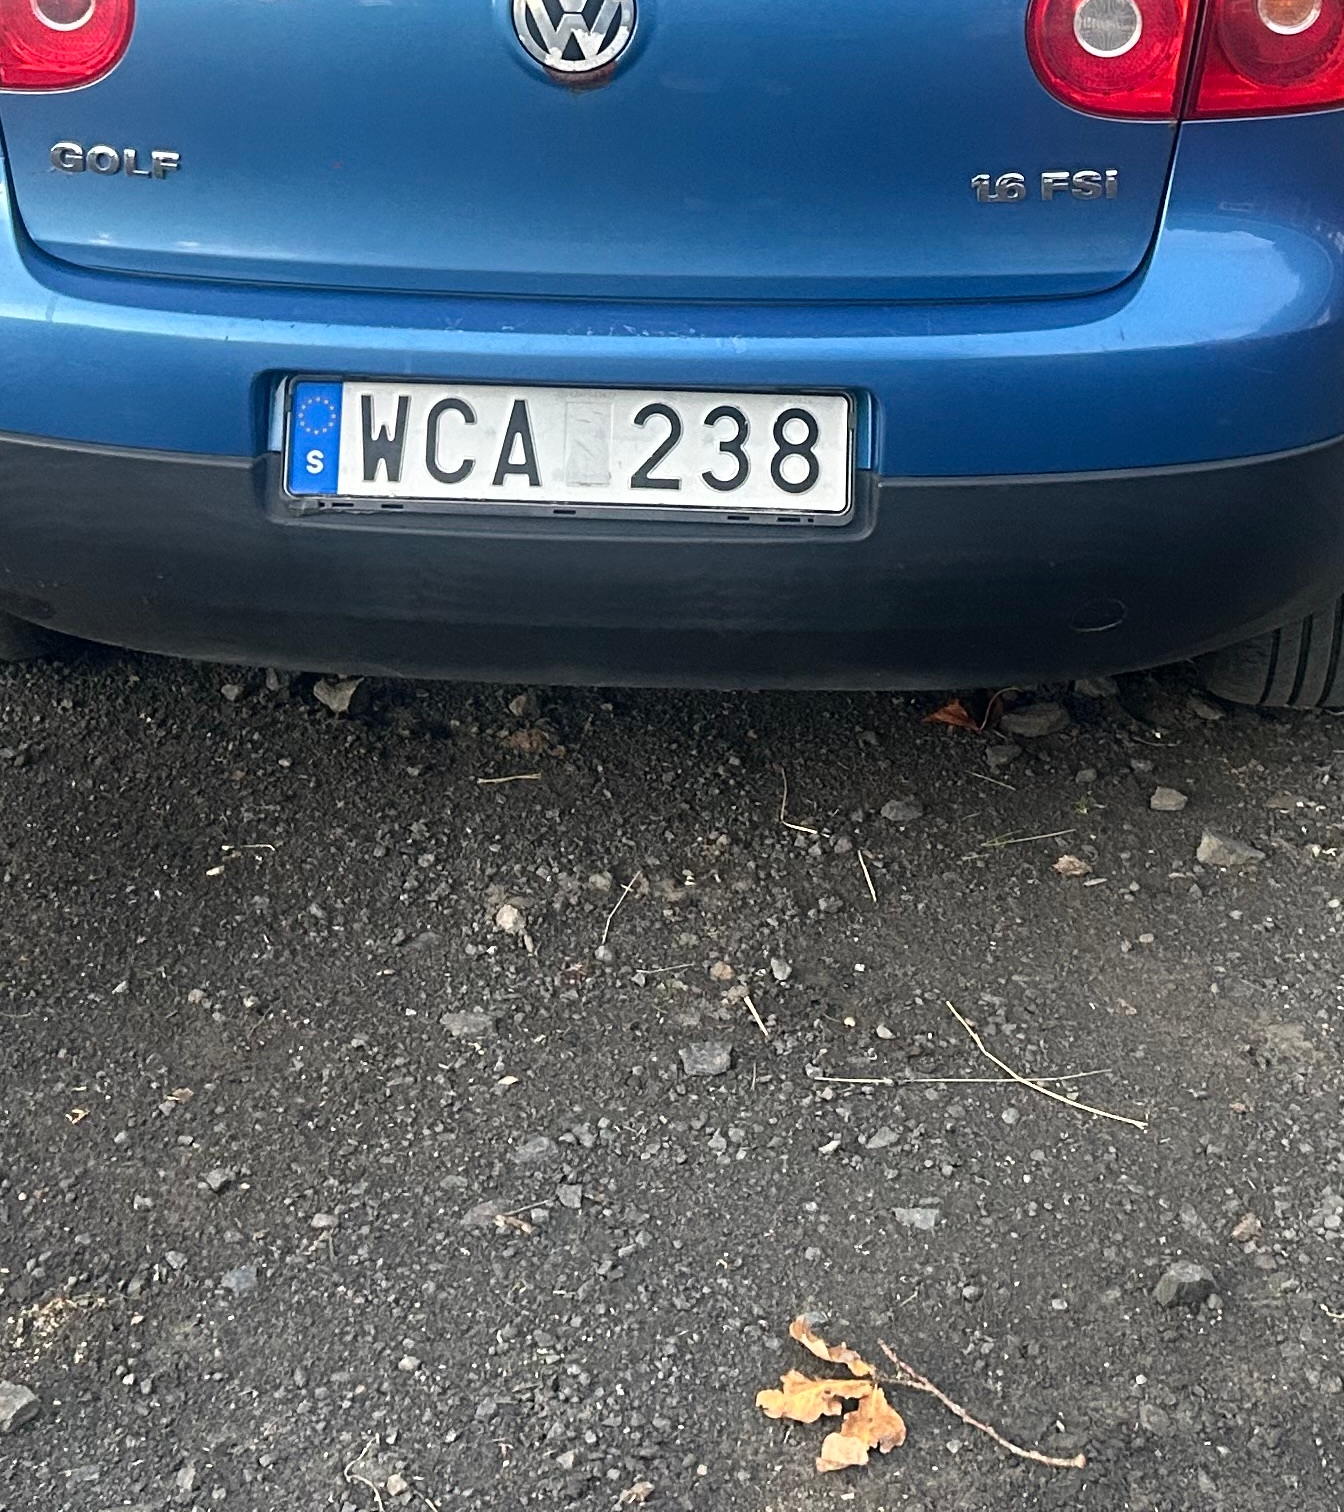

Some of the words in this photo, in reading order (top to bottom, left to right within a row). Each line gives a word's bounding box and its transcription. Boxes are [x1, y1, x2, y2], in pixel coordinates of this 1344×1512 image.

[50, 141, 180, 179] GOLF
[306, 449, 324, 474] S
[360, 394, 543, 487] WCA
[630, 402, 820, 494] 238
